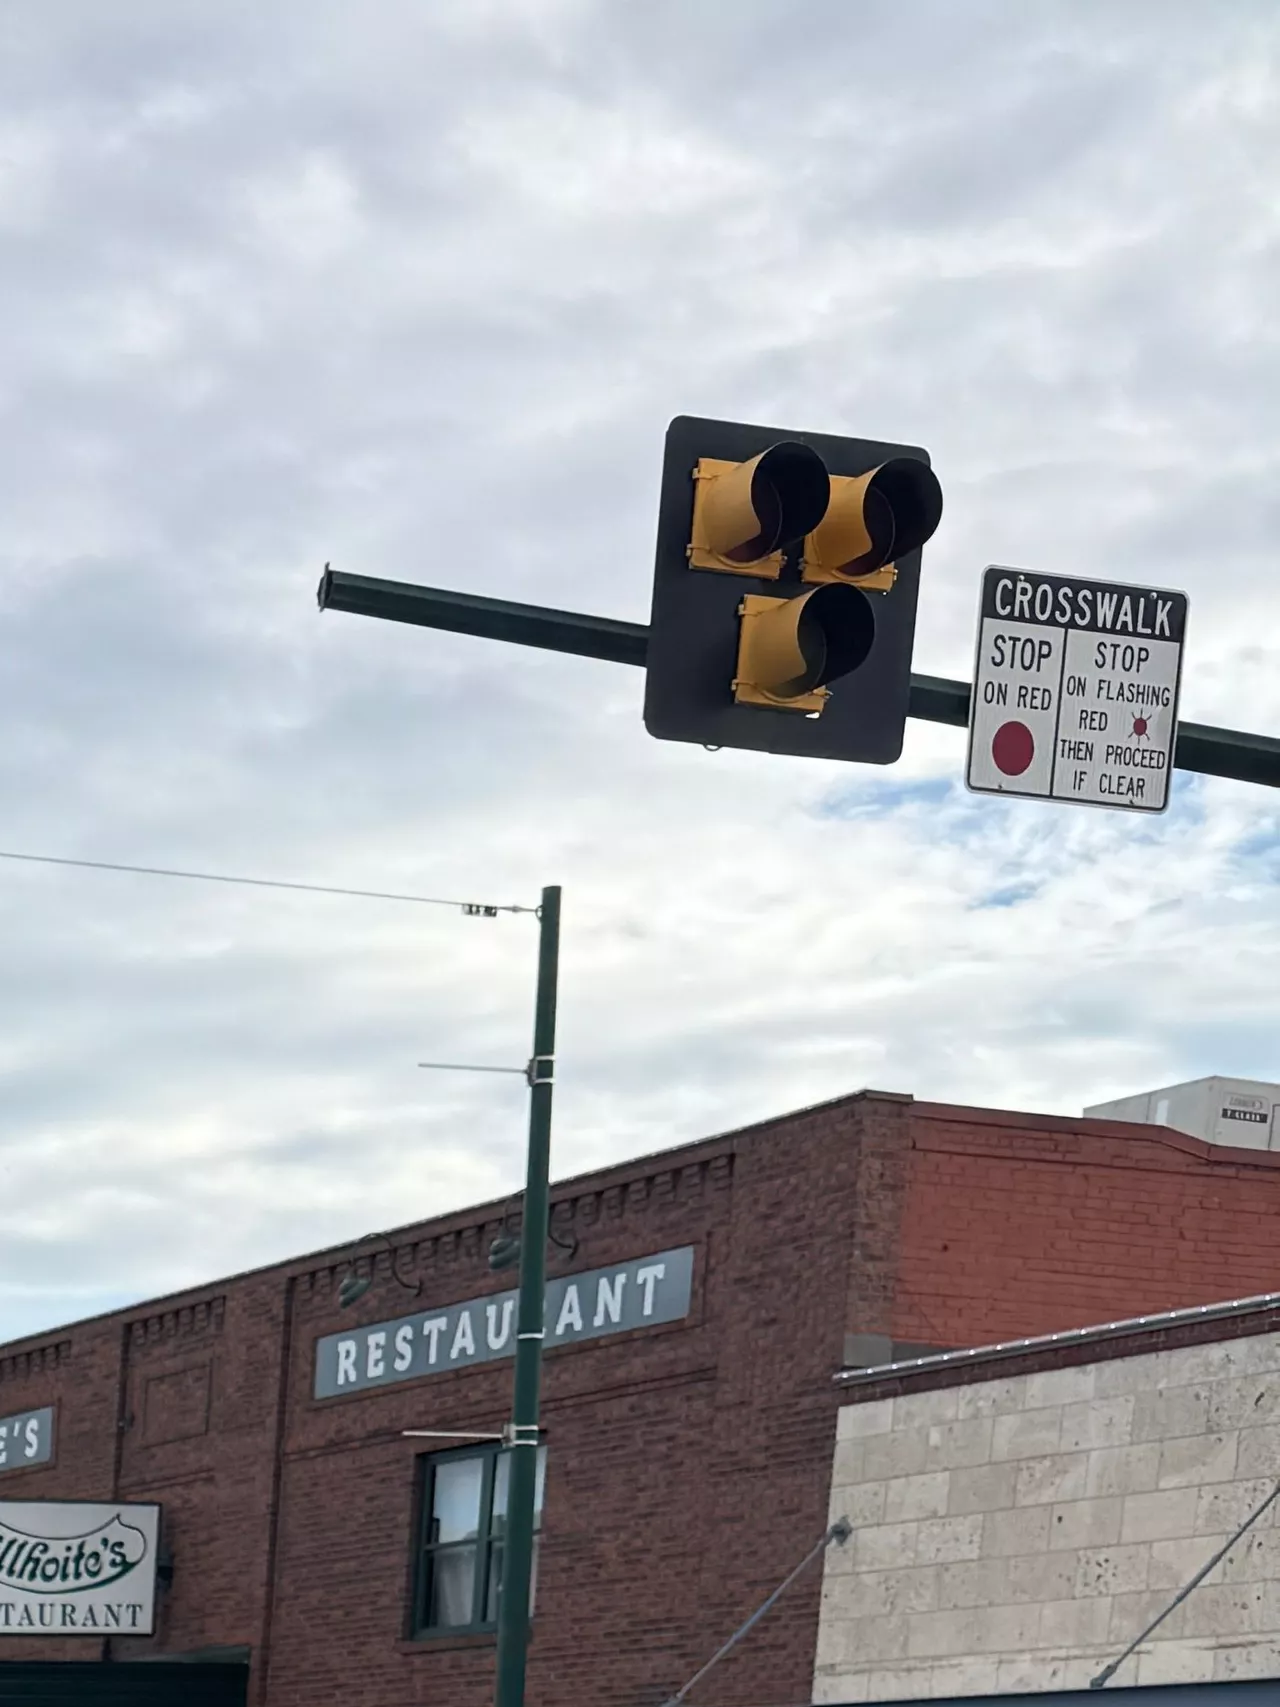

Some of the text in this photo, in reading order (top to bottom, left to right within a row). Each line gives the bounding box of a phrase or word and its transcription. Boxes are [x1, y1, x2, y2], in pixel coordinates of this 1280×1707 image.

[995, 577, 1173, 637] CROSSWALK
[991, 634, 1052, 673] STOP
[1094, 641, 1150, 674] STOP
[984, 680, 1052, 711] ON RED
[1066, 675, 1171, 708] ON FLASHING
[1079, 709, 1108, 732] RED
[1060, 739, 1166, 770] THEN PROCEED
[1073, 771, 1146, 798] IF CLEAR
[337, 1263, 666, 1385] RESTAUANT
